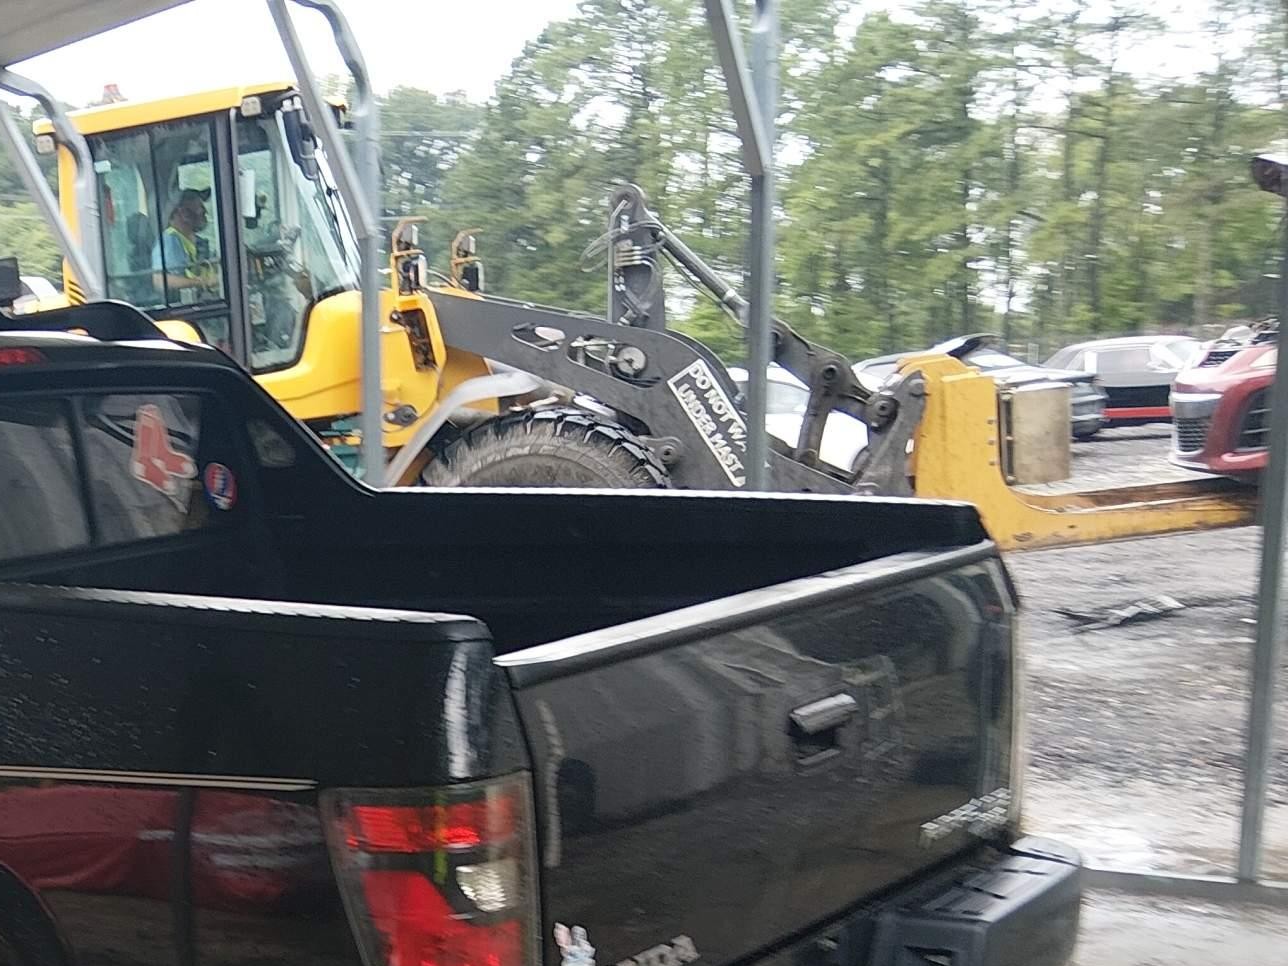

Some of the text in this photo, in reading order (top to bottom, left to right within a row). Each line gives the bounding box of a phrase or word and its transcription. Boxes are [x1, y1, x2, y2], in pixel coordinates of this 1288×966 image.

[678, 384, 745, 471] UNDER MAST
[688, 366, 712, 390] DO
[704, 391, 733, 423] NOT
